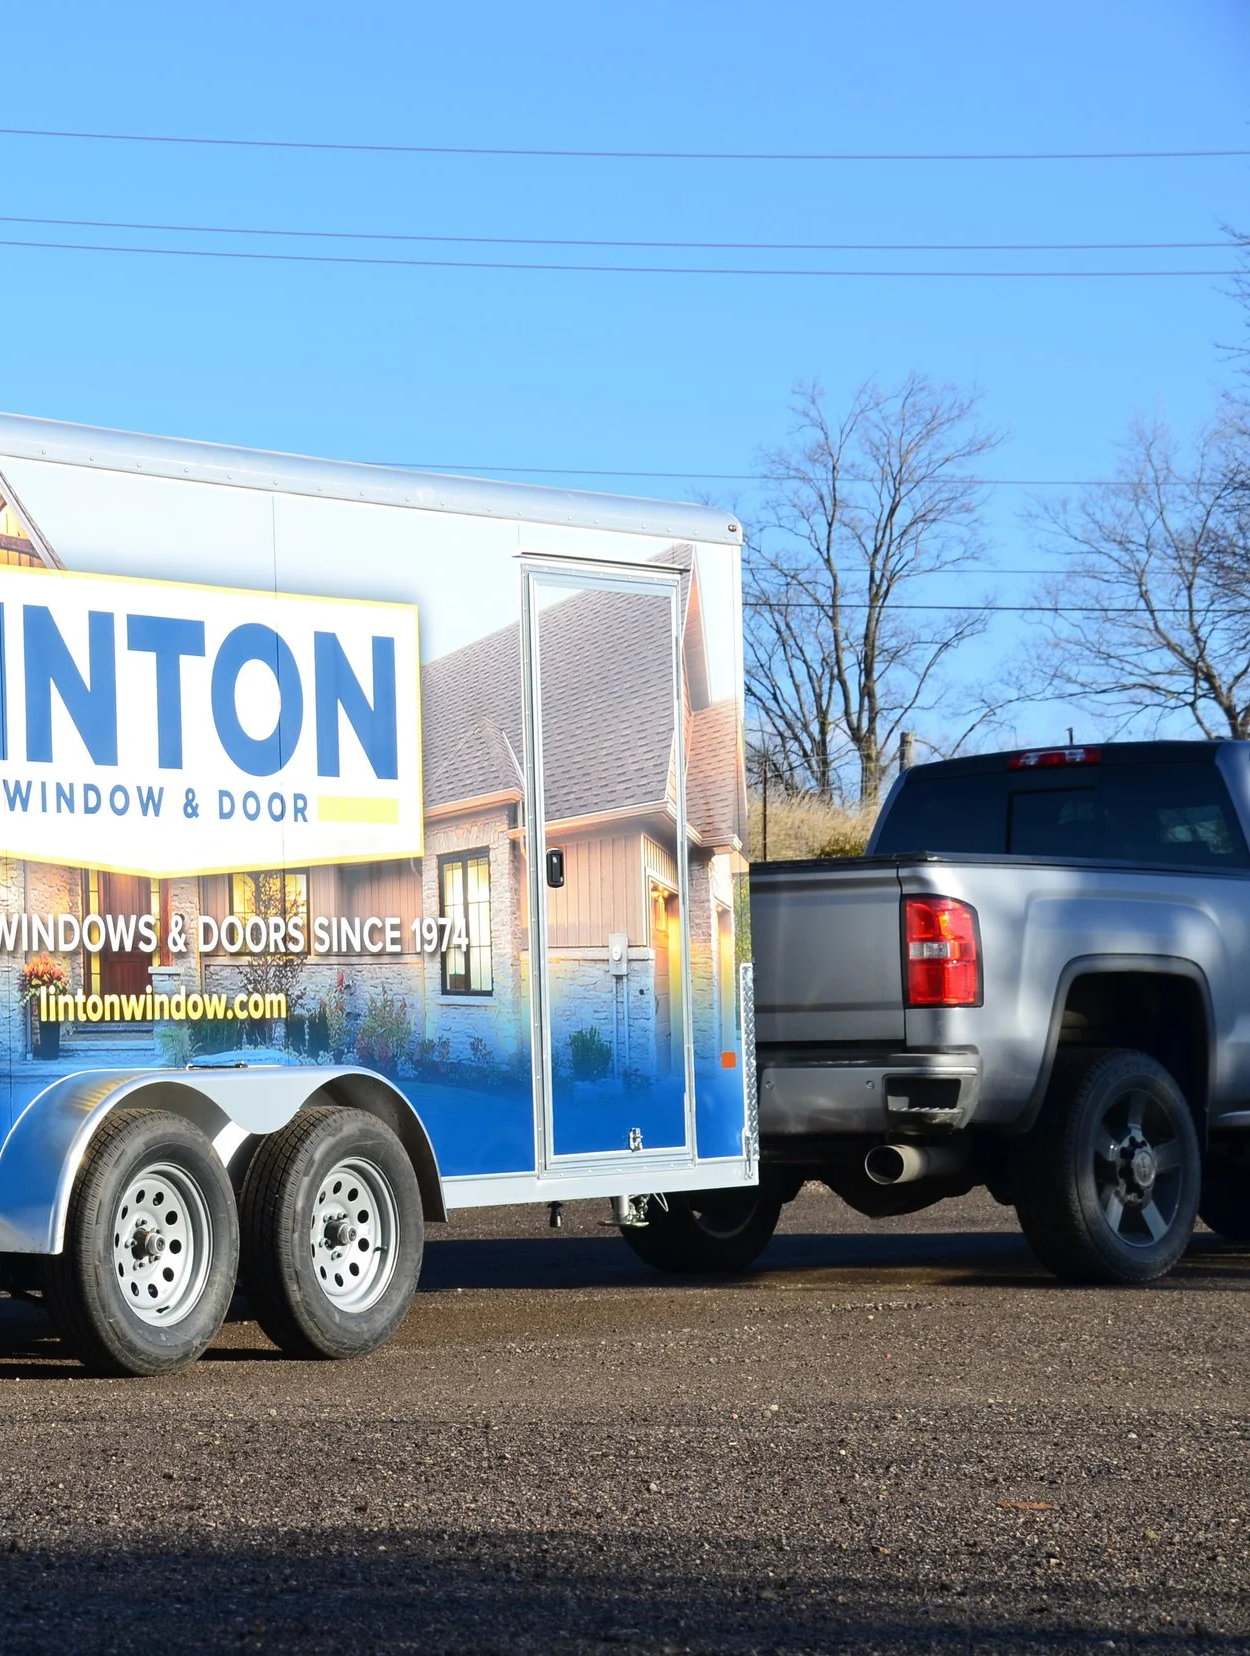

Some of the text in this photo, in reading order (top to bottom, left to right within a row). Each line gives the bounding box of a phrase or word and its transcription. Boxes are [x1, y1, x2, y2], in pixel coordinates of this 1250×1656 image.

[2, 779, 309, 823] WINDOW & DOOR
[168, 914, 187, 952] &
[198, 915, 305, 953] DOORS
[314, 916, 401, 952] SINCE
[411, 917, 469, 952] 1974
[41, 985, 287, 1022] lintonwindow.com
